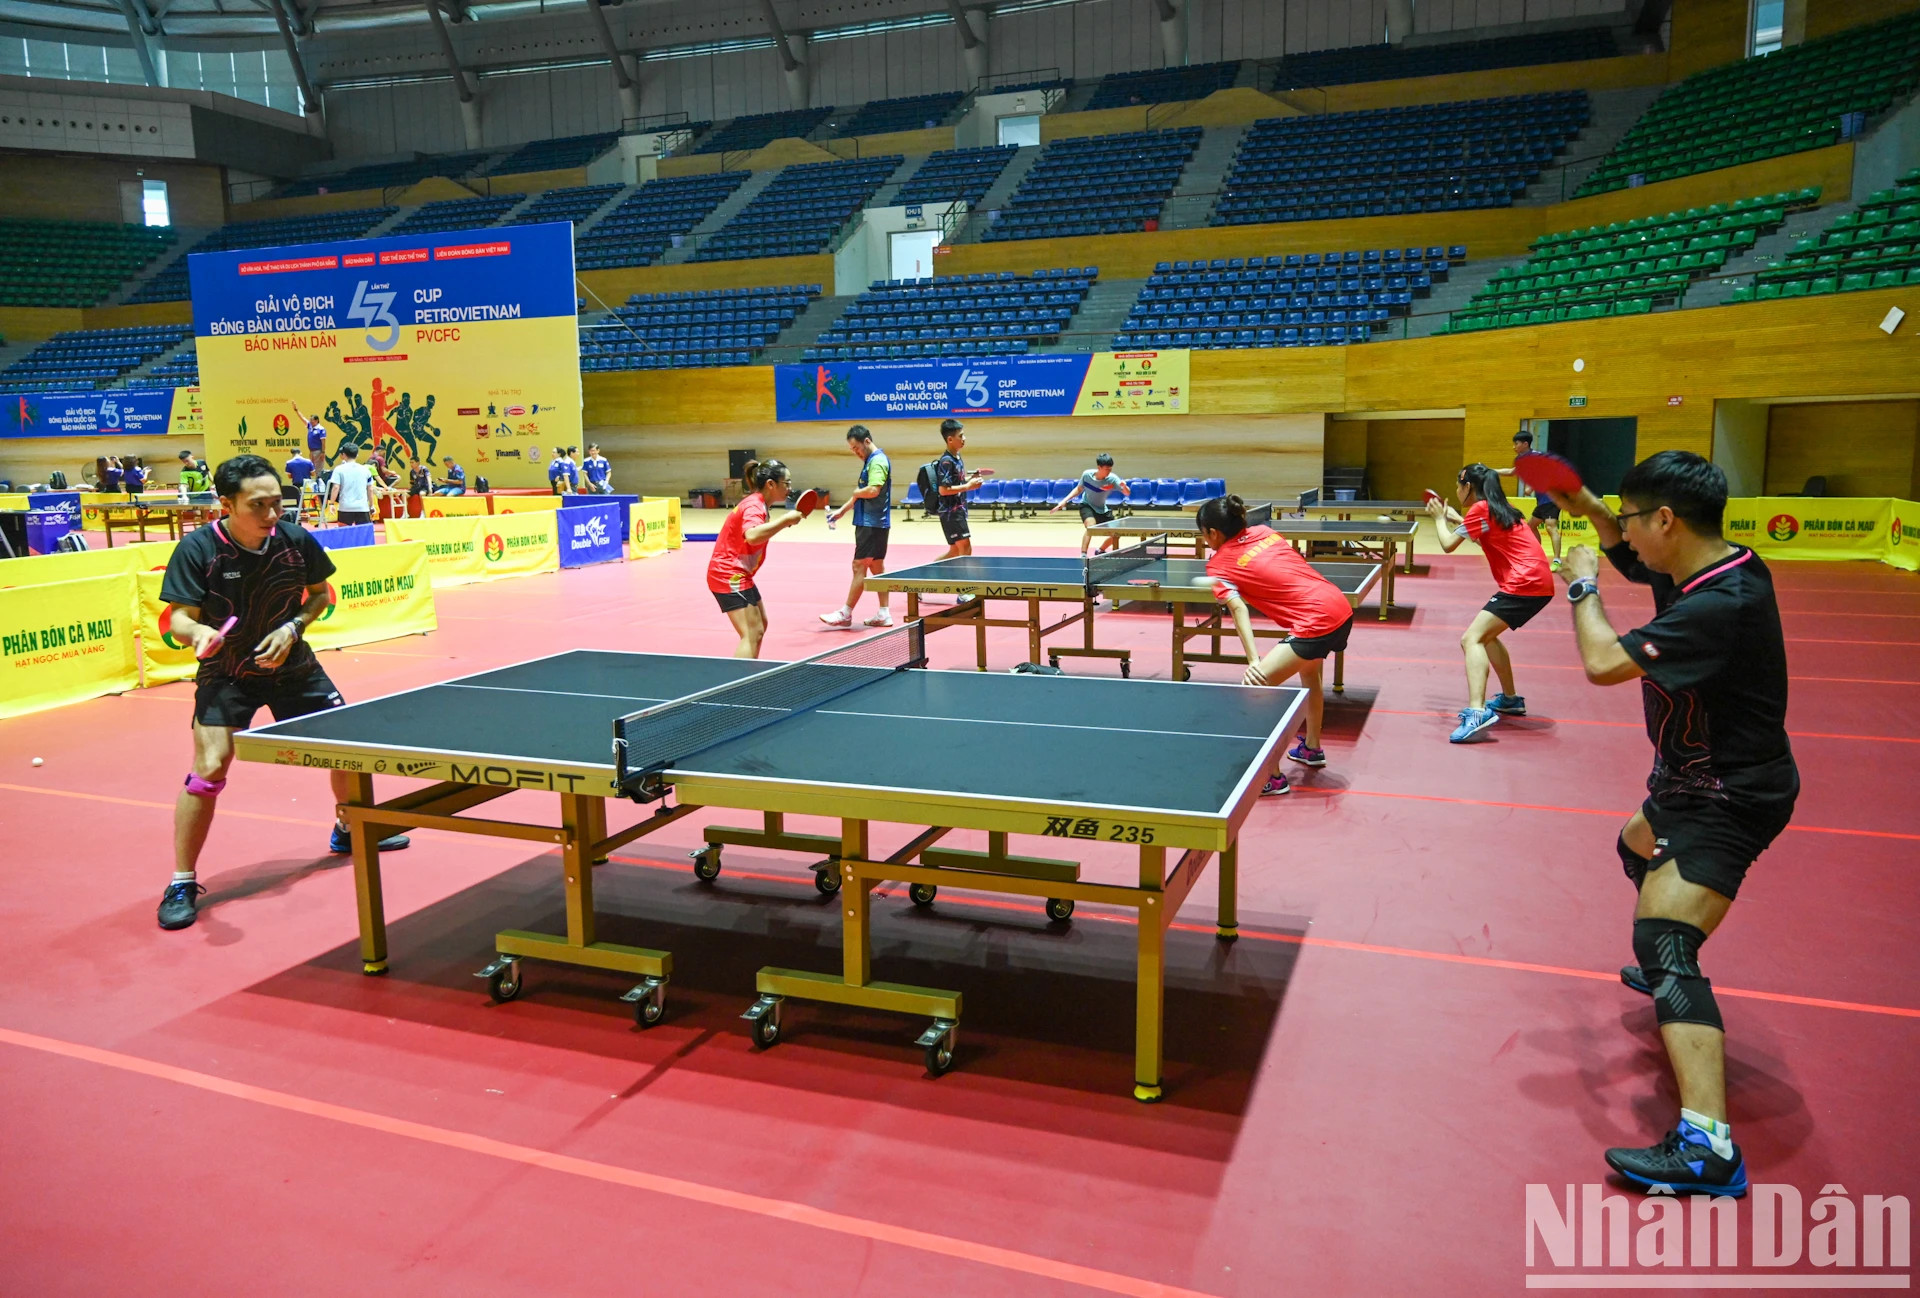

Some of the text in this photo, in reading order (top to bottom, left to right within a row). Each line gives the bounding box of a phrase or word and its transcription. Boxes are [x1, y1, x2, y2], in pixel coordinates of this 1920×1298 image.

[414, 288, 442, 304] CUP
[255, 294, 334, 314] GIẢI VÔ ĐỊCH
[415, 304, 521, 324] PETROVIETNAM
[210, 310, 336, 335] BÓNG BÀN QUỐC GIA
[416, 328, 461, 343] PVCFC
[244, 332, 337, 352] BÁO NHÂN DÂN
[896, 380, 948, 392] GIẢI VÔ ĐỊCH
[998, 380, 1017, 388] CUP
[864, 390, 948, 402] BÓNG BÀN QUỐC GIA
[998, 389, 1065, 398] PETROVIETNAM
[886, 402, 904, 411] BÁO
[905, 401, 929, 410] NHÂN
[930, 400, 948, 410] DÂN
[998, 400, 1028, 409] PVCFC
[124, 414, 162, 422] PETROVIETNAM
[496, 449, 520, 457] Vinamilk
[1573, 520, 1587, 530] MAU
[1730, 518, 1750, 530] PHÂN
[1804, 518, 1876, 531] PHÂN BÓN CÀ MAU
[571, 538, 592, 550] Double
[341, 575, 414, 600] PHÂN BÓN CÀ MAU
[903, 585, 925, 593] DOUBLE
[986, 586, 1058, 598] MOFIT
[2, 619, 112, 656] PHÂN BÓN CÀ MAU
[15, 658, 31, 669] HẠT
[33, 654, 60, 665] NGỌC
[303, 753, 363, 771] DOUBLE FISH
[451, 763, 585, 793] MOFIT
[1041, 816, 1155, 844] 双鱼 235
